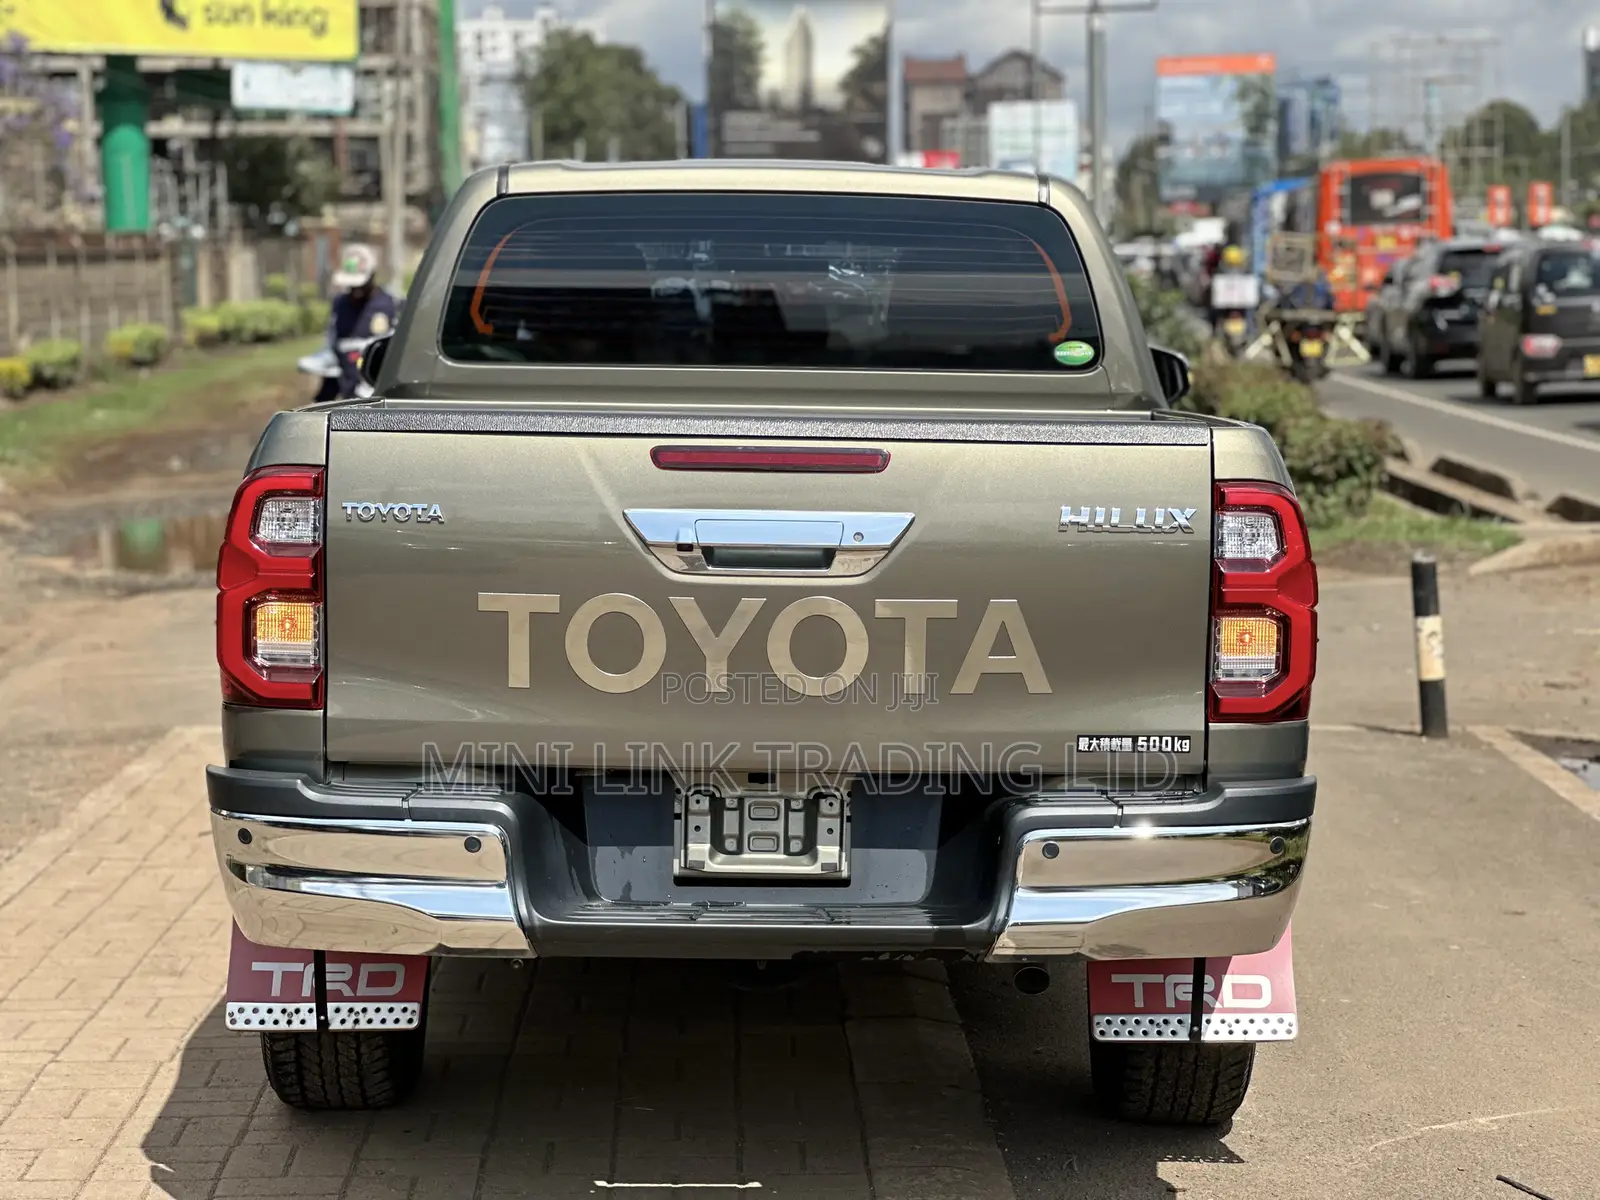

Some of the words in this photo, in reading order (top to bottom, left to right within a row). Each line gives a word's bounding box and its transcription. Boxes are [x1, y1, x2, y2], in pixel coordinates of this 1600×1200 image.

[203, 5, 255, 27] sun
[260, 0, 329, 39] king
[341, 501, 445, 524] TOYOTA
[1058, 504, 1197, 533] HILUX
[478, 592, 1053, 696] TOYOTA
[1078, 737, 1132, 752] 最大積載量
[1137, 736, 1190, 752] 500kg
[251, 961, 405, 997] TRD
[1111, 974, 1272, 1009] TRD
